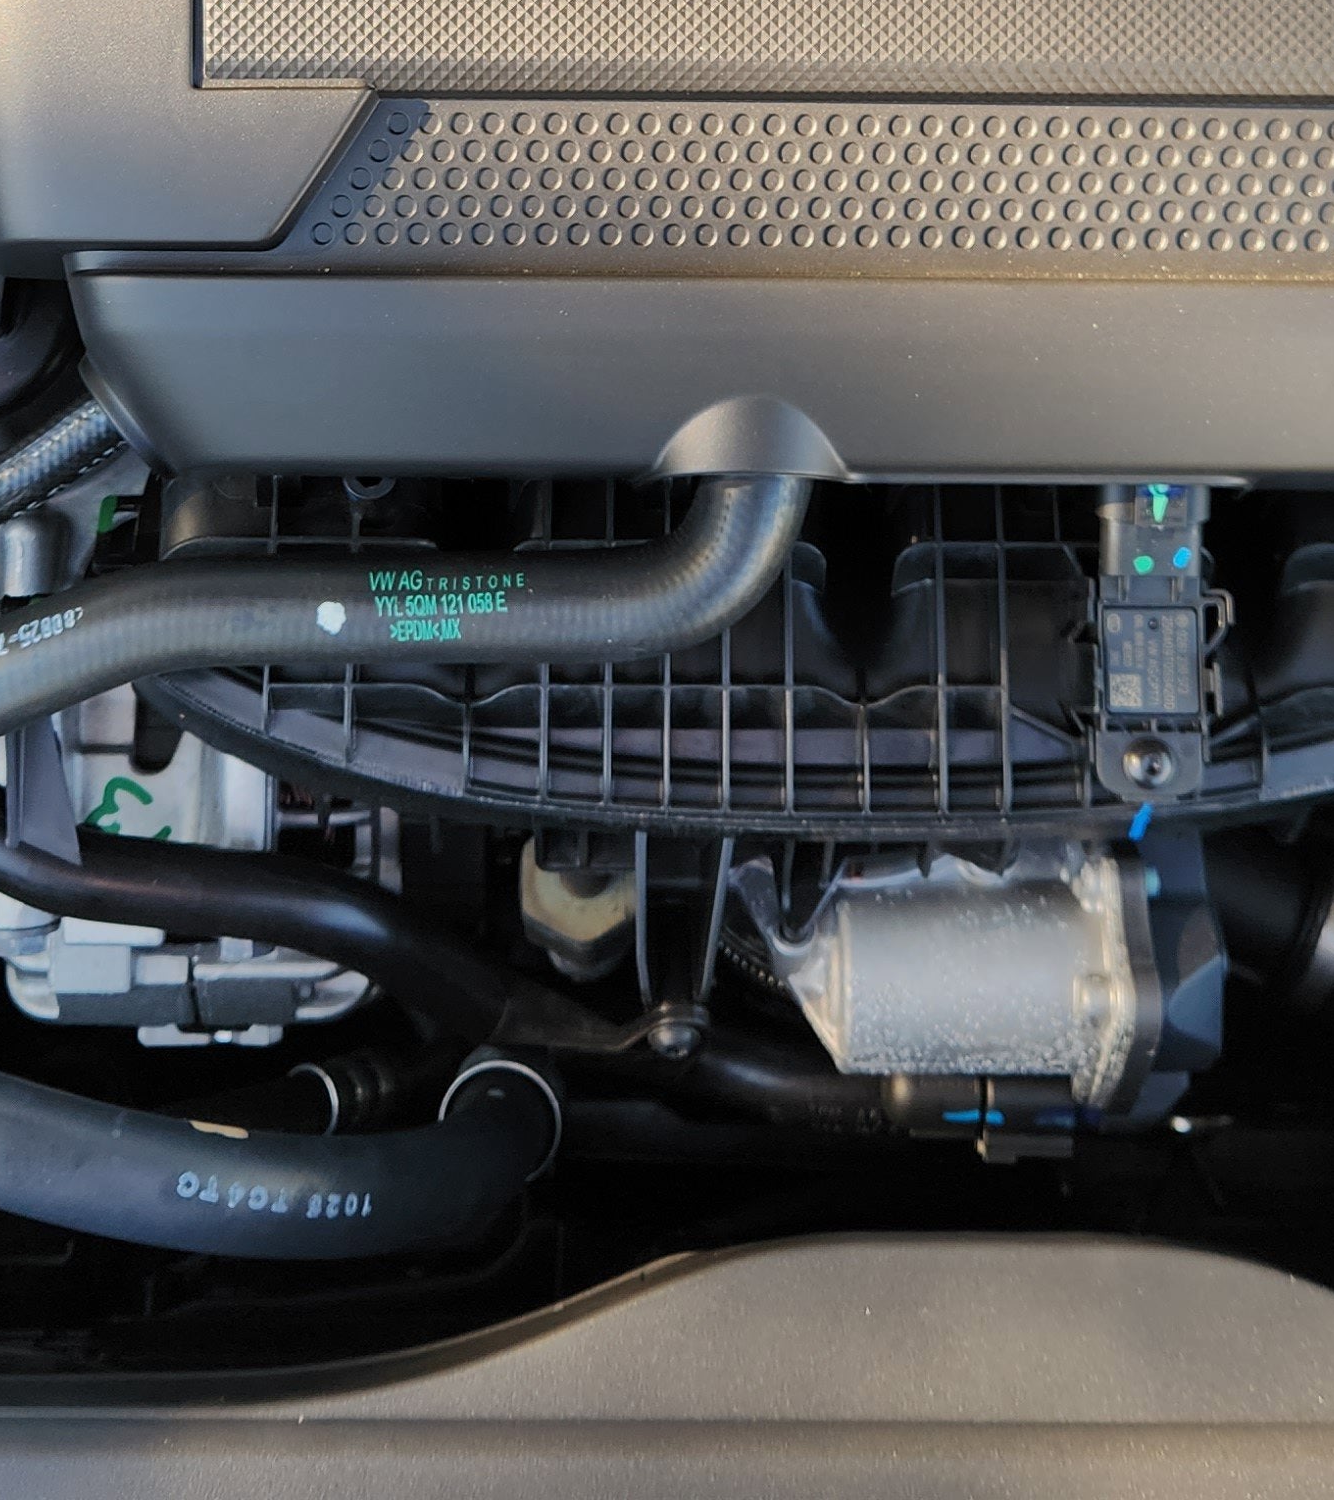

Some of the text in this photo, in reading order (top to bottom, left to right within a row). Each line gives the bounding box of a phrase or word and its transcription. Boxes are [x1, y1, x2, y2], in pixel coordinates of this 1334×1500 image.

[369, 570, 525, 592] VW AG TRISTONE
[375, 592, 508, 617] YYL 5QM 121 058 E
